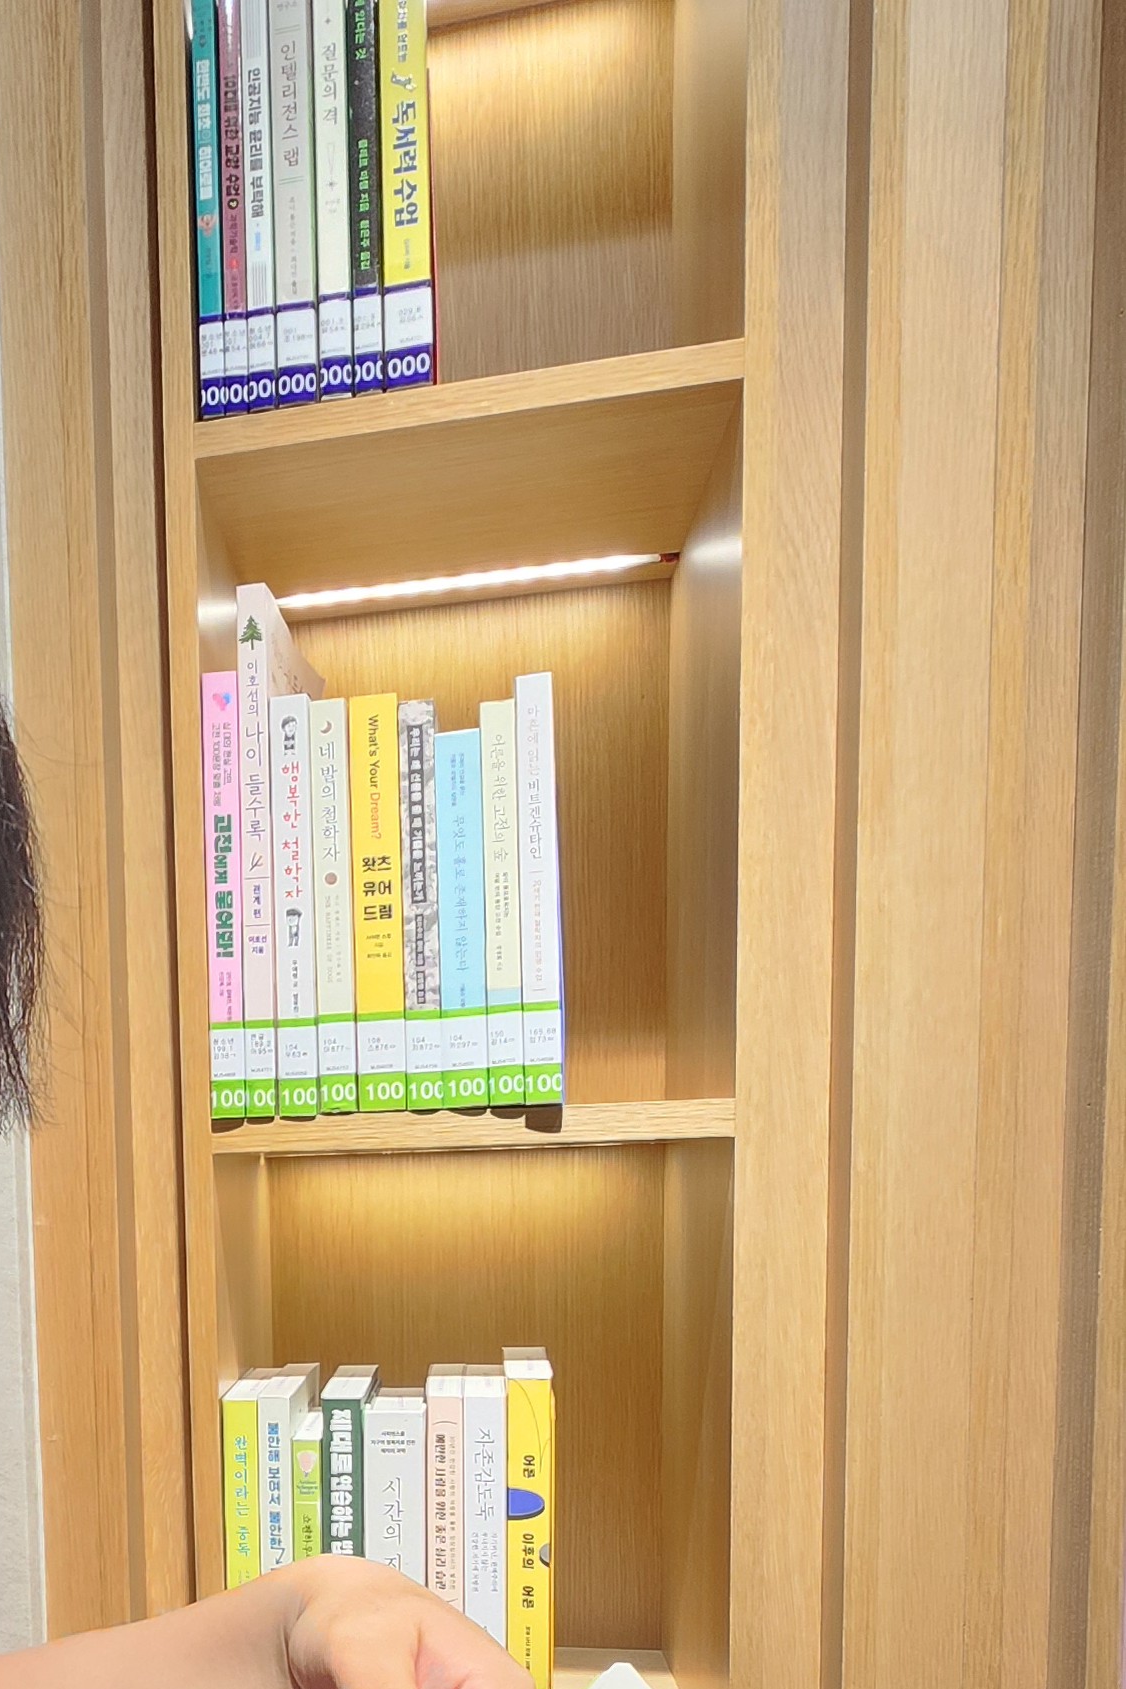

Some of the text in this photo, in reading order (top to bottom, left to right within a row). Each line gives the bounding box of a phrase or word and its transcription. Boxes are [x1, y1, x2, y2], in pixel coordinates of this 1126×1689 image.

[354, 13, 367, 60] 있다는 것
[248, 68, 262, 125] 인공지능
[281, 41, 299, 167] 인텔리전스 랩
[321, 43, 338, 125] 질문의 격
[225, 144, 240, 169] 교양
[249, 130, 264, 172] 윤리를
[392, 100, 418, 227] 독서력 수업
[226, 174, 240, 197] 수업
[250, 176, 264, 218] 부탁해
[359, 193, 369, 212] 지음
[278, 373, 316, 395] 000
[388, 352, 430, 379] 000
[245, 660, 265, 841] 이호선의 나이 들수록
[368, 715, 381, 840] What's Your Dream?
[490, 733, 510, 862] 어른을 위한 고전의 숲
[319, 742, 339, 862] 네 발의 철학자
[528, 779, 542, 859] 비트겐슈타인
[214, 814, 232, 885] 고전에게
[281, 761, 303, 899] 행복한 철학자
[453, 815, 465, 852] 무엇도
[362, 855, 392, 873] 왓츠
[454, 855, 466, 878] 홀로
[363, 880, 392, 896] 유어
[454, 881, 468, 932] 존재하지
[215, 890, 234, 958] 물어봐!
[363, 904, 392, 920] 드림
[456, 935, 468, 971] 않는다
[211, 1089, 244, 1108] 100
[282, 1087, 317, 1106] 100
[321, 1083, 356, 1104] 100
[366, 1081, 404, 1100] 100
[410, 1081, 443, 1100] 100
[449, 1077, 485, 1097] 100
[490, 1074, 524, 1094] 100
[526, 1073, 562, 1093] 100
[329, 1409, 353, 1474] 제대로
[268, 1422, 282, 1550] 불안해 보여서 불안한
[474, 1428, 496, 1521] 자존감도둑
[523, 1454, 535, 1479] 어른
[235, 1436, 250, 1557] 완벽이라는 중독
[331, 1476, 353, 1538] 연습하는
[382, 1477, 404, 1546] 시간의
[435, 1434, 446, 1591] 예민한 사람을 위한 좋은 심리 습관
[302, 1515, 314, 1557] 쇼펜하우
[522, 1534, 534, 1569] 이후의
[522, 1586, 534, 1609] 어른
